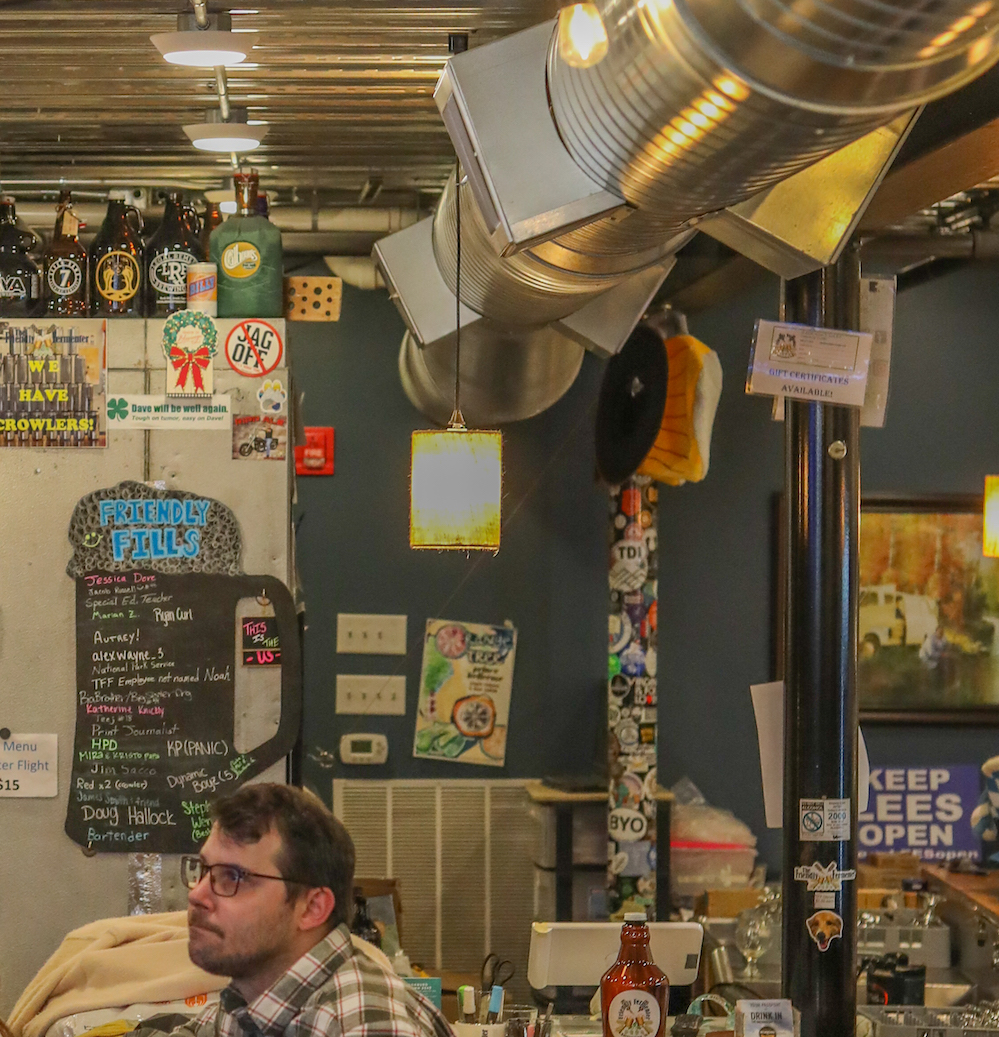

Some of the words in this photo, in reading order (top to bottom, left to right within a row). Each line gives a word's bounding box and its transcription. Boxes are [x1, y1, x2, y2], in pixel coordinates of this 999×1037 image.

[60, 270, 71, 287] 7
[189, 275, 216, 296] BILLY
[237, 324, 274, 351] JAG
[232, 343, 268, 368] OFF
[28, 360, 60, 373] WE
[769, 368, 787, 378] GIFT
[789, 371, 849, 385] CERTIFICATES
[18, 389, 69, 402] HAVE
[782, 384, 833, 398] AVAILABLE!
[131, 404, 152, 413] Dave
[154, 404, 169, 413] will
[171, 404, 181, 413] be
[183, 404, 201, 413] well
[203, 404, 228, 414] again.
[100, 499, 211, 527] FRIENDLY
[111, 527, 201, 562] FILLS
[618, 545, 642, 560] TDI
[84, 574, 127, 587] Jessica
[85, 597, 118, 611] Special
[243, 621, 267, 636] THIS
[262, 637, 280, 648] THE
[91, 663, 128, 675] National
[150, 661, 175, 669] Service
[91, 677, 115, 690] TFF
[118, 673, 155, 687] Employee
[158, 672, 172, 683] not
[173, 668, 200, 682] named
[203, 665, 231, 682] Noah
[86, 703, 132, 715] Katherine
[91, 724, 119, 736] Print
[122, 722, 180, 736] Journalist
[3, 741, 37, 752] Menu
[91, 738, 118, 751] HPD
[17, 760, 50, 773] Flight
[121, 764, 157, 775] Sacco
[76, 777, 95, 790] Red
[166, 768, 208, 789] Dynamic
[868, 768, 951, 792] KEEP
[80, 804, 119, 827] Doug
[127, 805, 177, 826] Hallock
[827, 812, 847, 820] 2000
[610, 814, 644, 833] BYO
[87, 827, 150, 842] Bartender
[858, 823, 954, 847] OPEN
[750, 1011, 772, 1020] DRINK
[774, 1011, 783, 1020] IN
